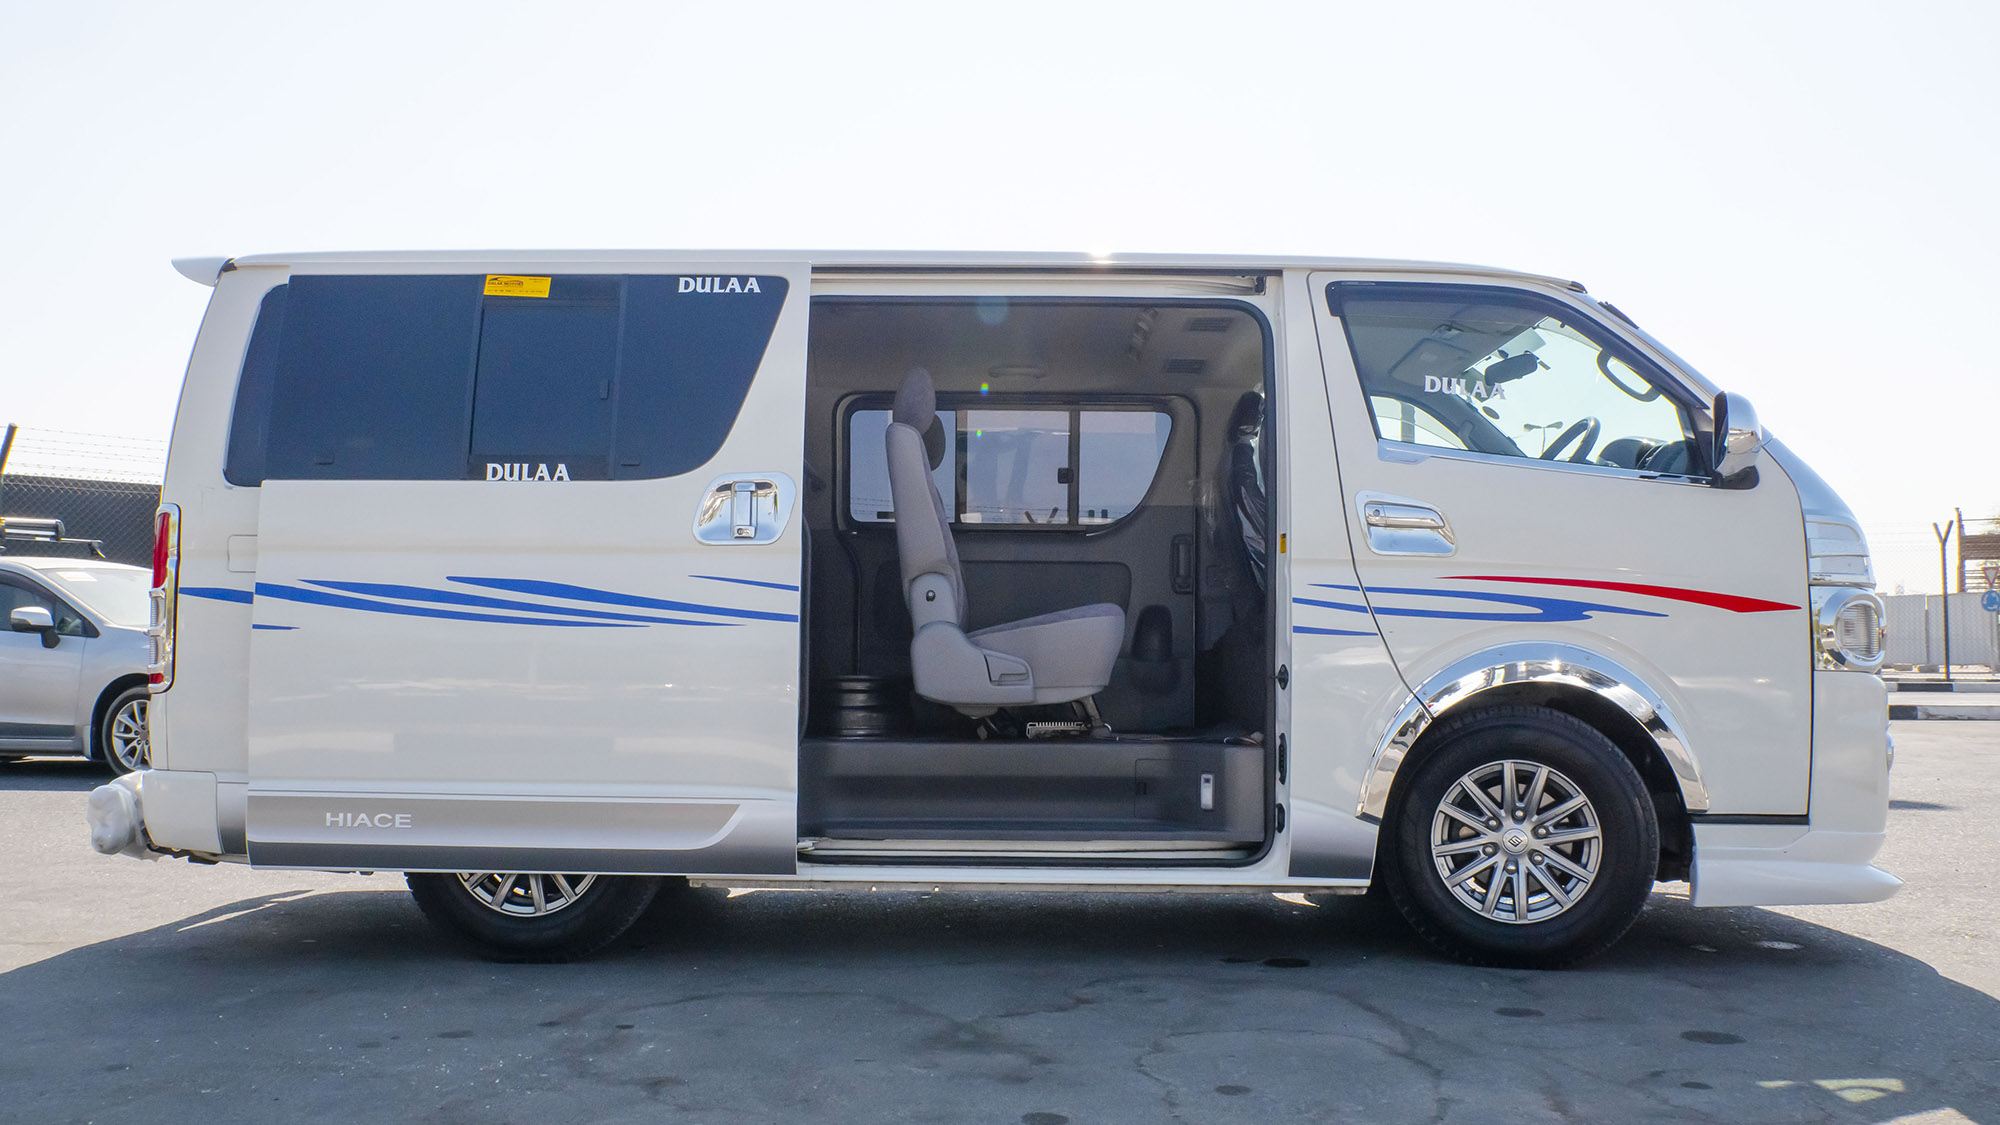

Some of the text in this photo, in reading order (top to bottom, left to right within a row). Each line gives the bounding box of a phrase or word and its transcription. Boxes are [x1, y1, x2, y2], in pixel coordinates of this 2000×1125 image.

[678, 277, 761, 293] DULAA
[1424, 375, 1506, 400] DULAA
[486, 463, 570, 480] DULAA
[325, 812, 412, 828] HIACE
